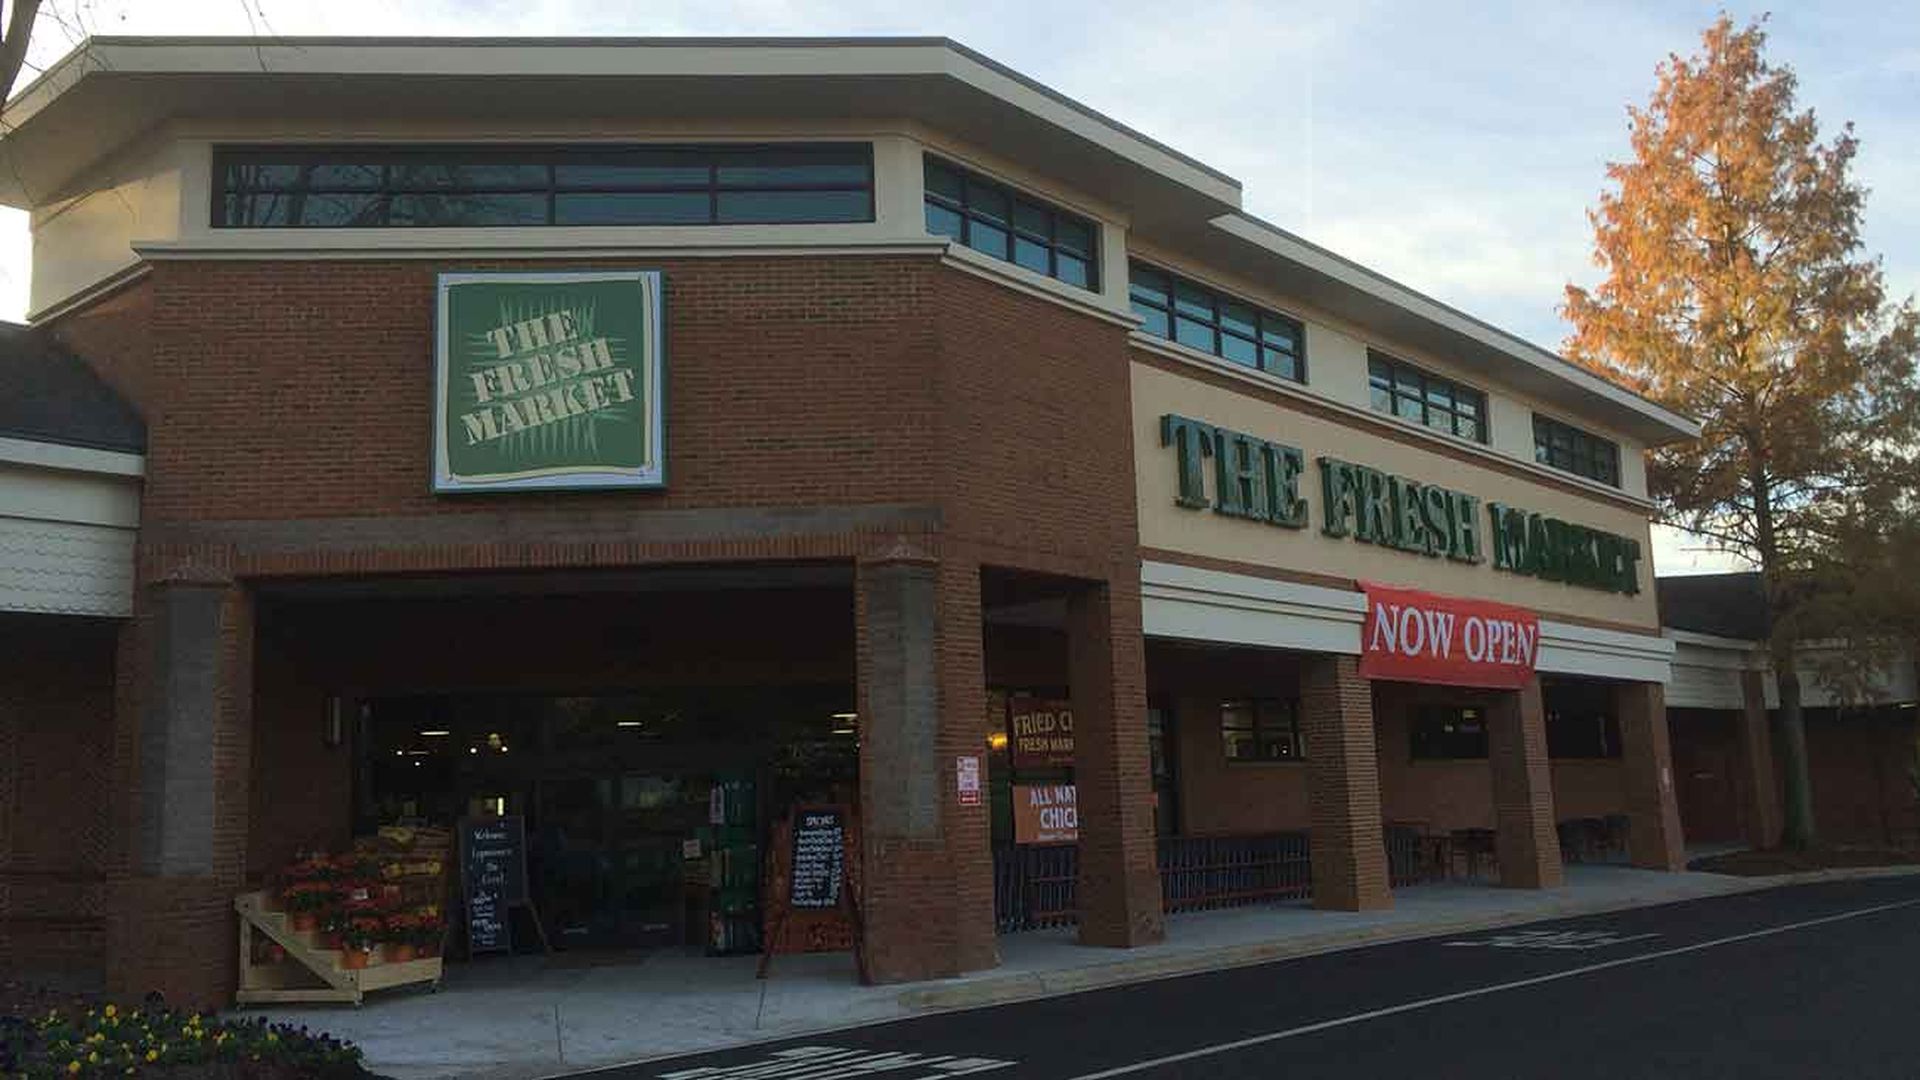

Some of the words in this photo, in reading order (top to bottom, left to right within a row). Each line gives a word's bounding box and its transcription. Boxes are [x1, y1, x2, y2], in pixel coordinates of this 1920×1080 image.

[486, 310, 578, 359] THE
[469, 337, 615, 403] FRESH
[460, 368, 635, 446] MARKET
[1160, 413, 1309, 529] THE
[1317, 456, 1486, 565] FRESH
[1487, 501, 1642, 598] MARKET
[1369, 601, 1455, 661] NOW
[1463, 616, 1537, 668] OPEN
[1014, 712, 1056, 736] FRIED
[1030, 786, 1052, 806] ALL
